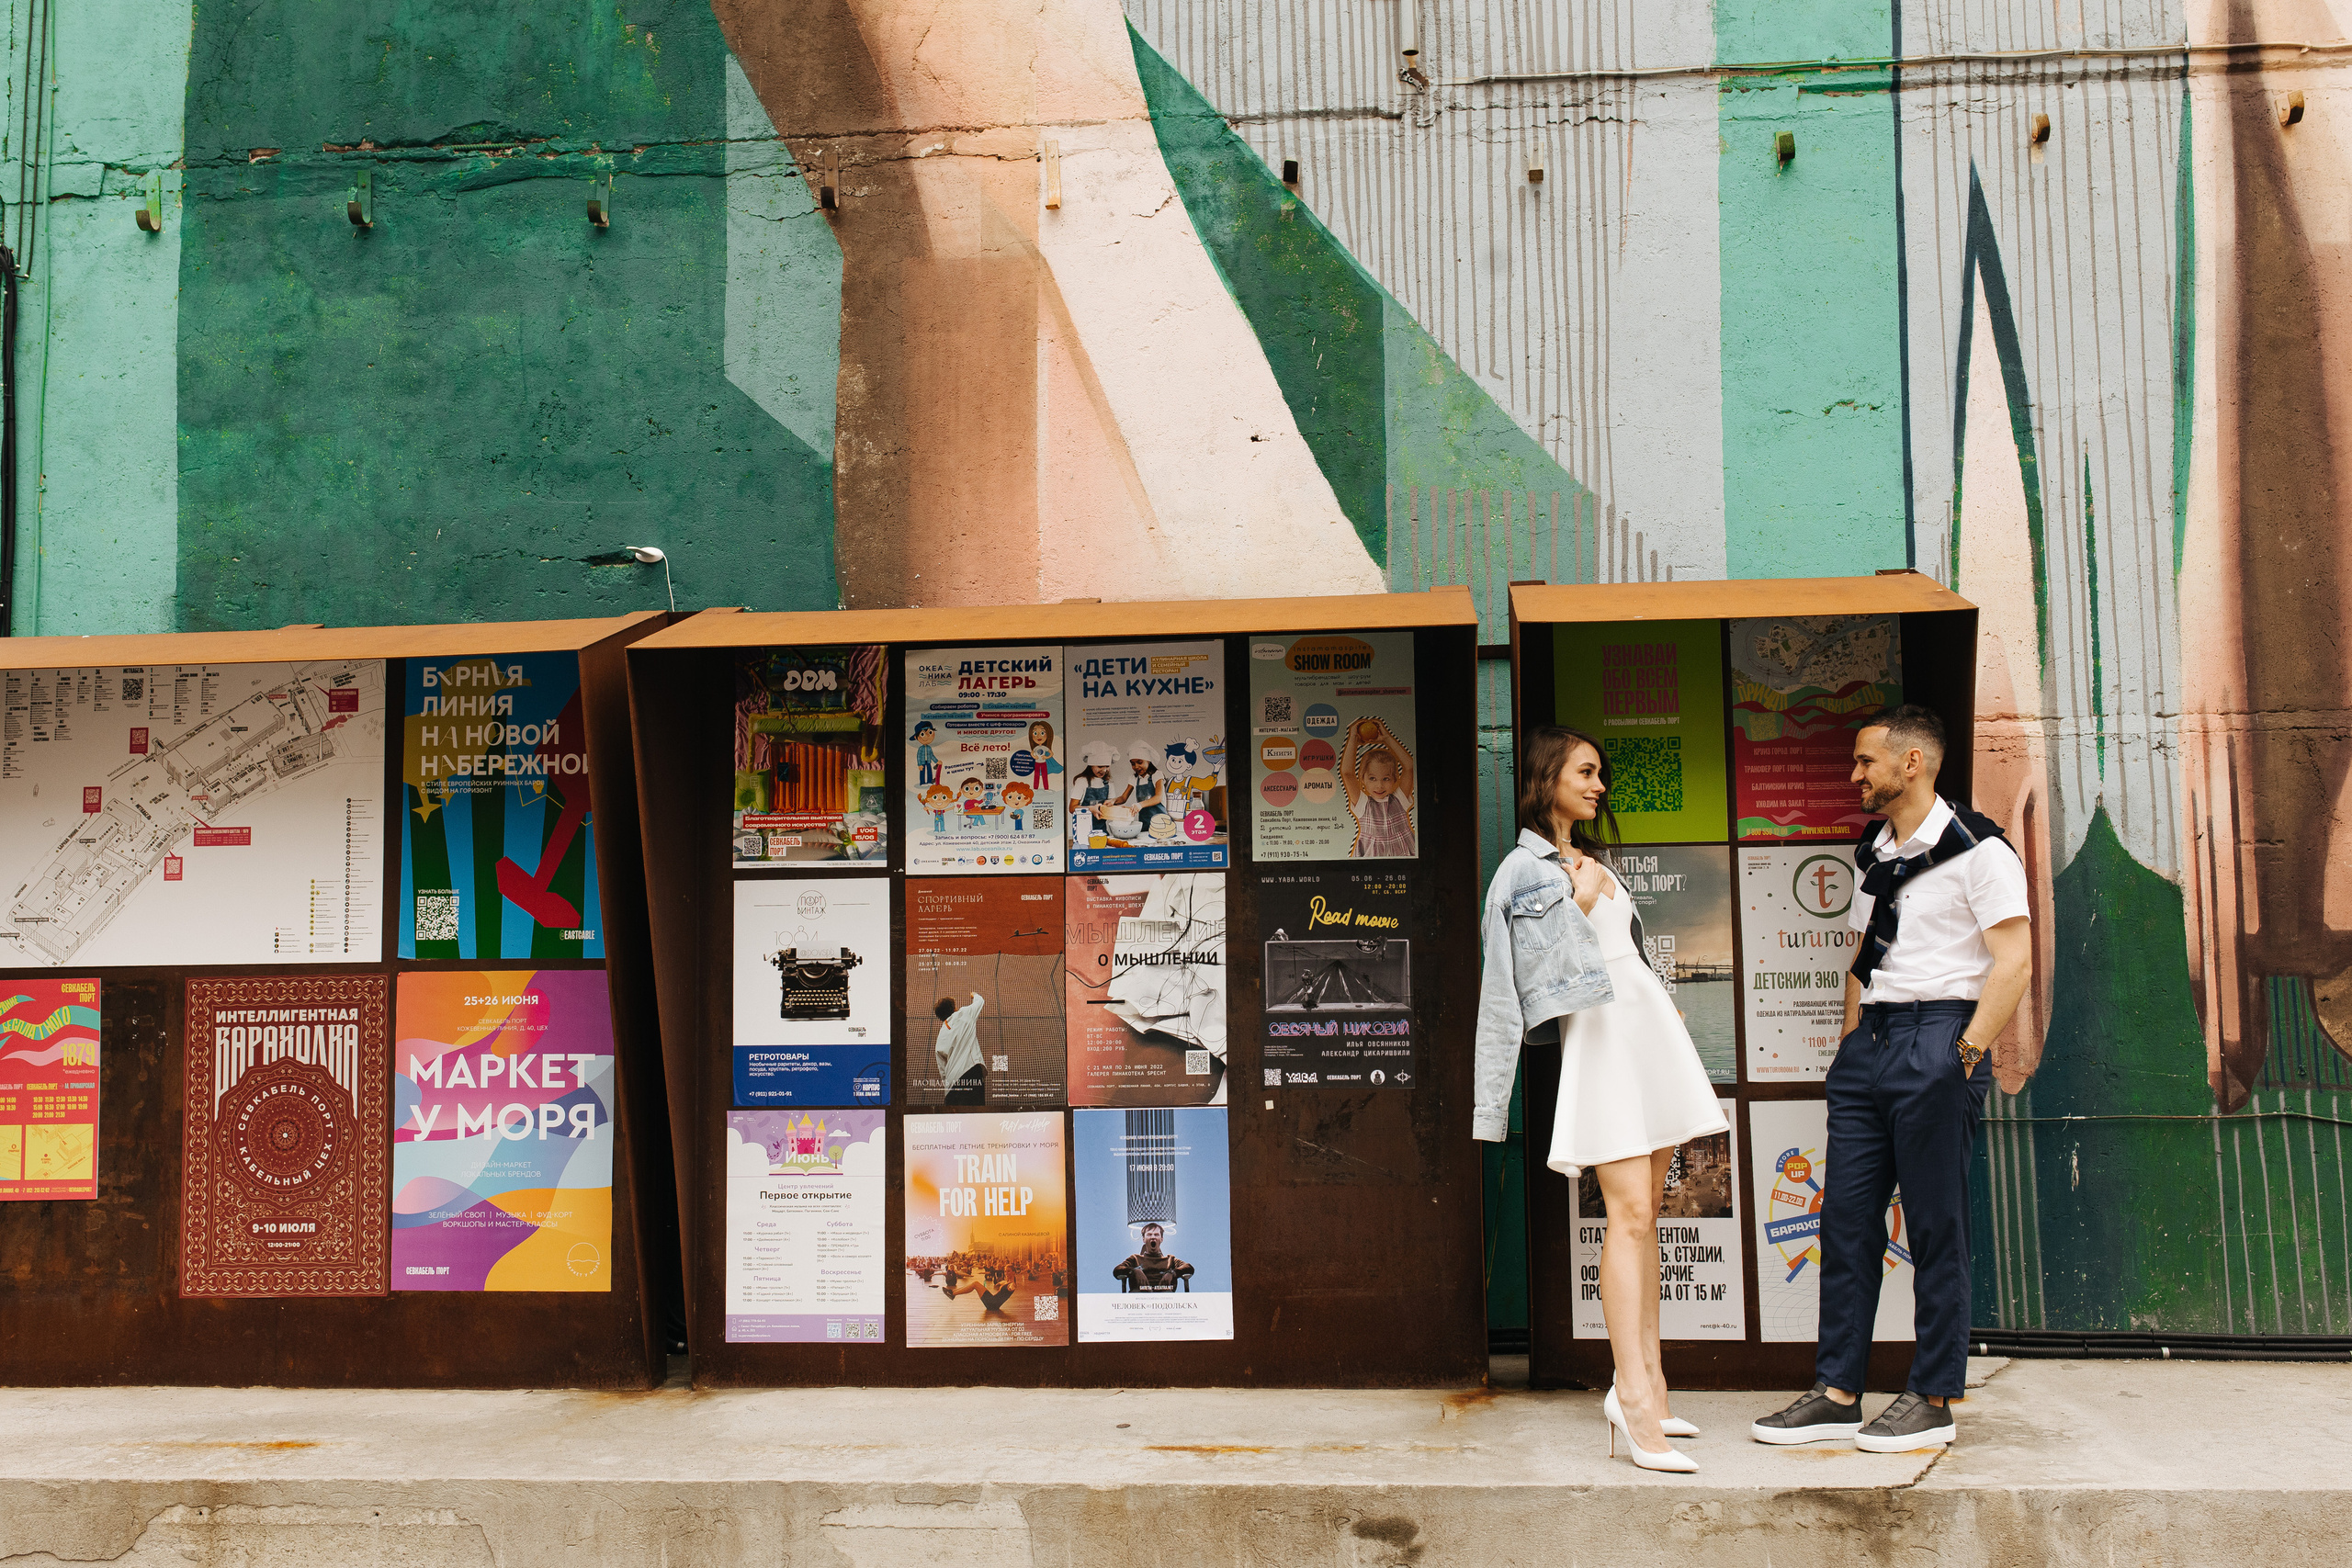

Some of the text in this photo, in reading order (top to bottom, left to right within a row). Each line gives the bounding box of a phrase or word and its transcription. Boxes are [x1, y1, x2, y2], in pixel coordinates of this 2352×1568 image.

[1601, 641, 1678, 667] УЗНАВАЙ
[958, 656, 1052, 676] ДЕТСКИЙ
[1073, 656, 1147, 679] «ДЕТИ
[1294, 653, 1372, 671] SHOW ROOM
[958, 675, 1036, 690] ЛАГЕРЬ
[1601, 668, 1631, 689] ОБО
[1082, 676, 1215, 699] НА КУХНЕ»
[1603, 690, 1679, 716] ПЕРВЫМ
[1737, 682, 1885, 714] ПРИЧАЛ СЕВКАБЕЛЬ
[421, 695, 513, 717] ЛИНИЯ
[1306, 716, 1336, 725] ОДЕЖДА
[1638, 716, 1680, 726] СЕВКАБЕЛЬ ПОРТ
[421, 719, 560, 749] НА НОВОЙ
[960, 742, 1011, 752] Всё лето!
[1266, 749, 1293, 758] Книги
[1304, 782, 1332, 790] АРОМАТЫ
[1788, 799, 1805, 807] ЗАКАТ
[1193, 814, 1205, 829] 2
[769, 837, 801, 846] СЕВКАБЕЛЬ
[769, 847, 785, 856] ПОРТ
[1652, 874, 1688, 892] ПОРТ?
[917, 893, 983, 904] СПОРТИВНЫЙ
[797, 907, 826, 915] ВИНТАЖ
[918, 904, 953, 913] ЛАГЕРЬ
[1355, 911, 1399, 929] movie
[1114, 952, 1218, 966] МЫШЛЕНИИ
[61, 982, 96, 993] СЕВКАБЕЛЬ
[79, 992, 96, 1003] ПОРТ
[464, 995, 538, 1006] 25+26 ИЮНЯ
[2, 1005, 72, 1040] БЕСПЛАТНОГО
[215, 1008, 358, 1023] ИНТЕЛЛИГЕНТНАЯ
[61, 1043, 96, 1066] 1879
[749, 1053, 809, 1061] РЕТРОТОВАРЫ
[214, 1023, 358, 1122] БАРАХОЛКА
[410, 1054, 595, 1089] МАРКЕТ
[952, 1078, 982, 1087] ЛЕНИНА
[238, 1084, 334, 1131] СЕВКАБЕЛЬ ПОРТ
[410, 1102, 595, 1142] У МОРЯ
[239, 1143, 333, 1186] КАБЕЛЬНЫЙ ЦЕХ
[785, 1150, 830, 1165] Июнь
[1778, 1150, 1795, 1168] STORE
[953, 1154, 1017, 1184] TRAIN
[1159, 1163, 1174, 1171] 20:00
[1787, 1162, 1808, 1170] POP
[507, 1170, 541, 1179] БРЕНДОВ
[760, 1190, 853, 1201] Первое открытие
[939, 1186, 1034, 1217] FOR HELP
[428, 1210, 572, 1219] ЗЕЛЁНЫЙ СВОП МУЗЫКА ФУД-КОРТ
[252, 1223, 316, 1234] 9-10 ИЮЛЯ
[442, 1220, 558, 1228] ВОРКШОПЫ МАСТЕР-КЛАССЫ
[1770, 1218, 1821, 1238] БАРАХО
[1674, 1246, 1725, 1264] СТУДИИ,
[405, 1266, 450, 1275] СЕВКАБЕЛЬ ПОРТ
[1676, 1284, 1690, 1301] ОТ
[1694, 1285, 1707, 1301] 15
